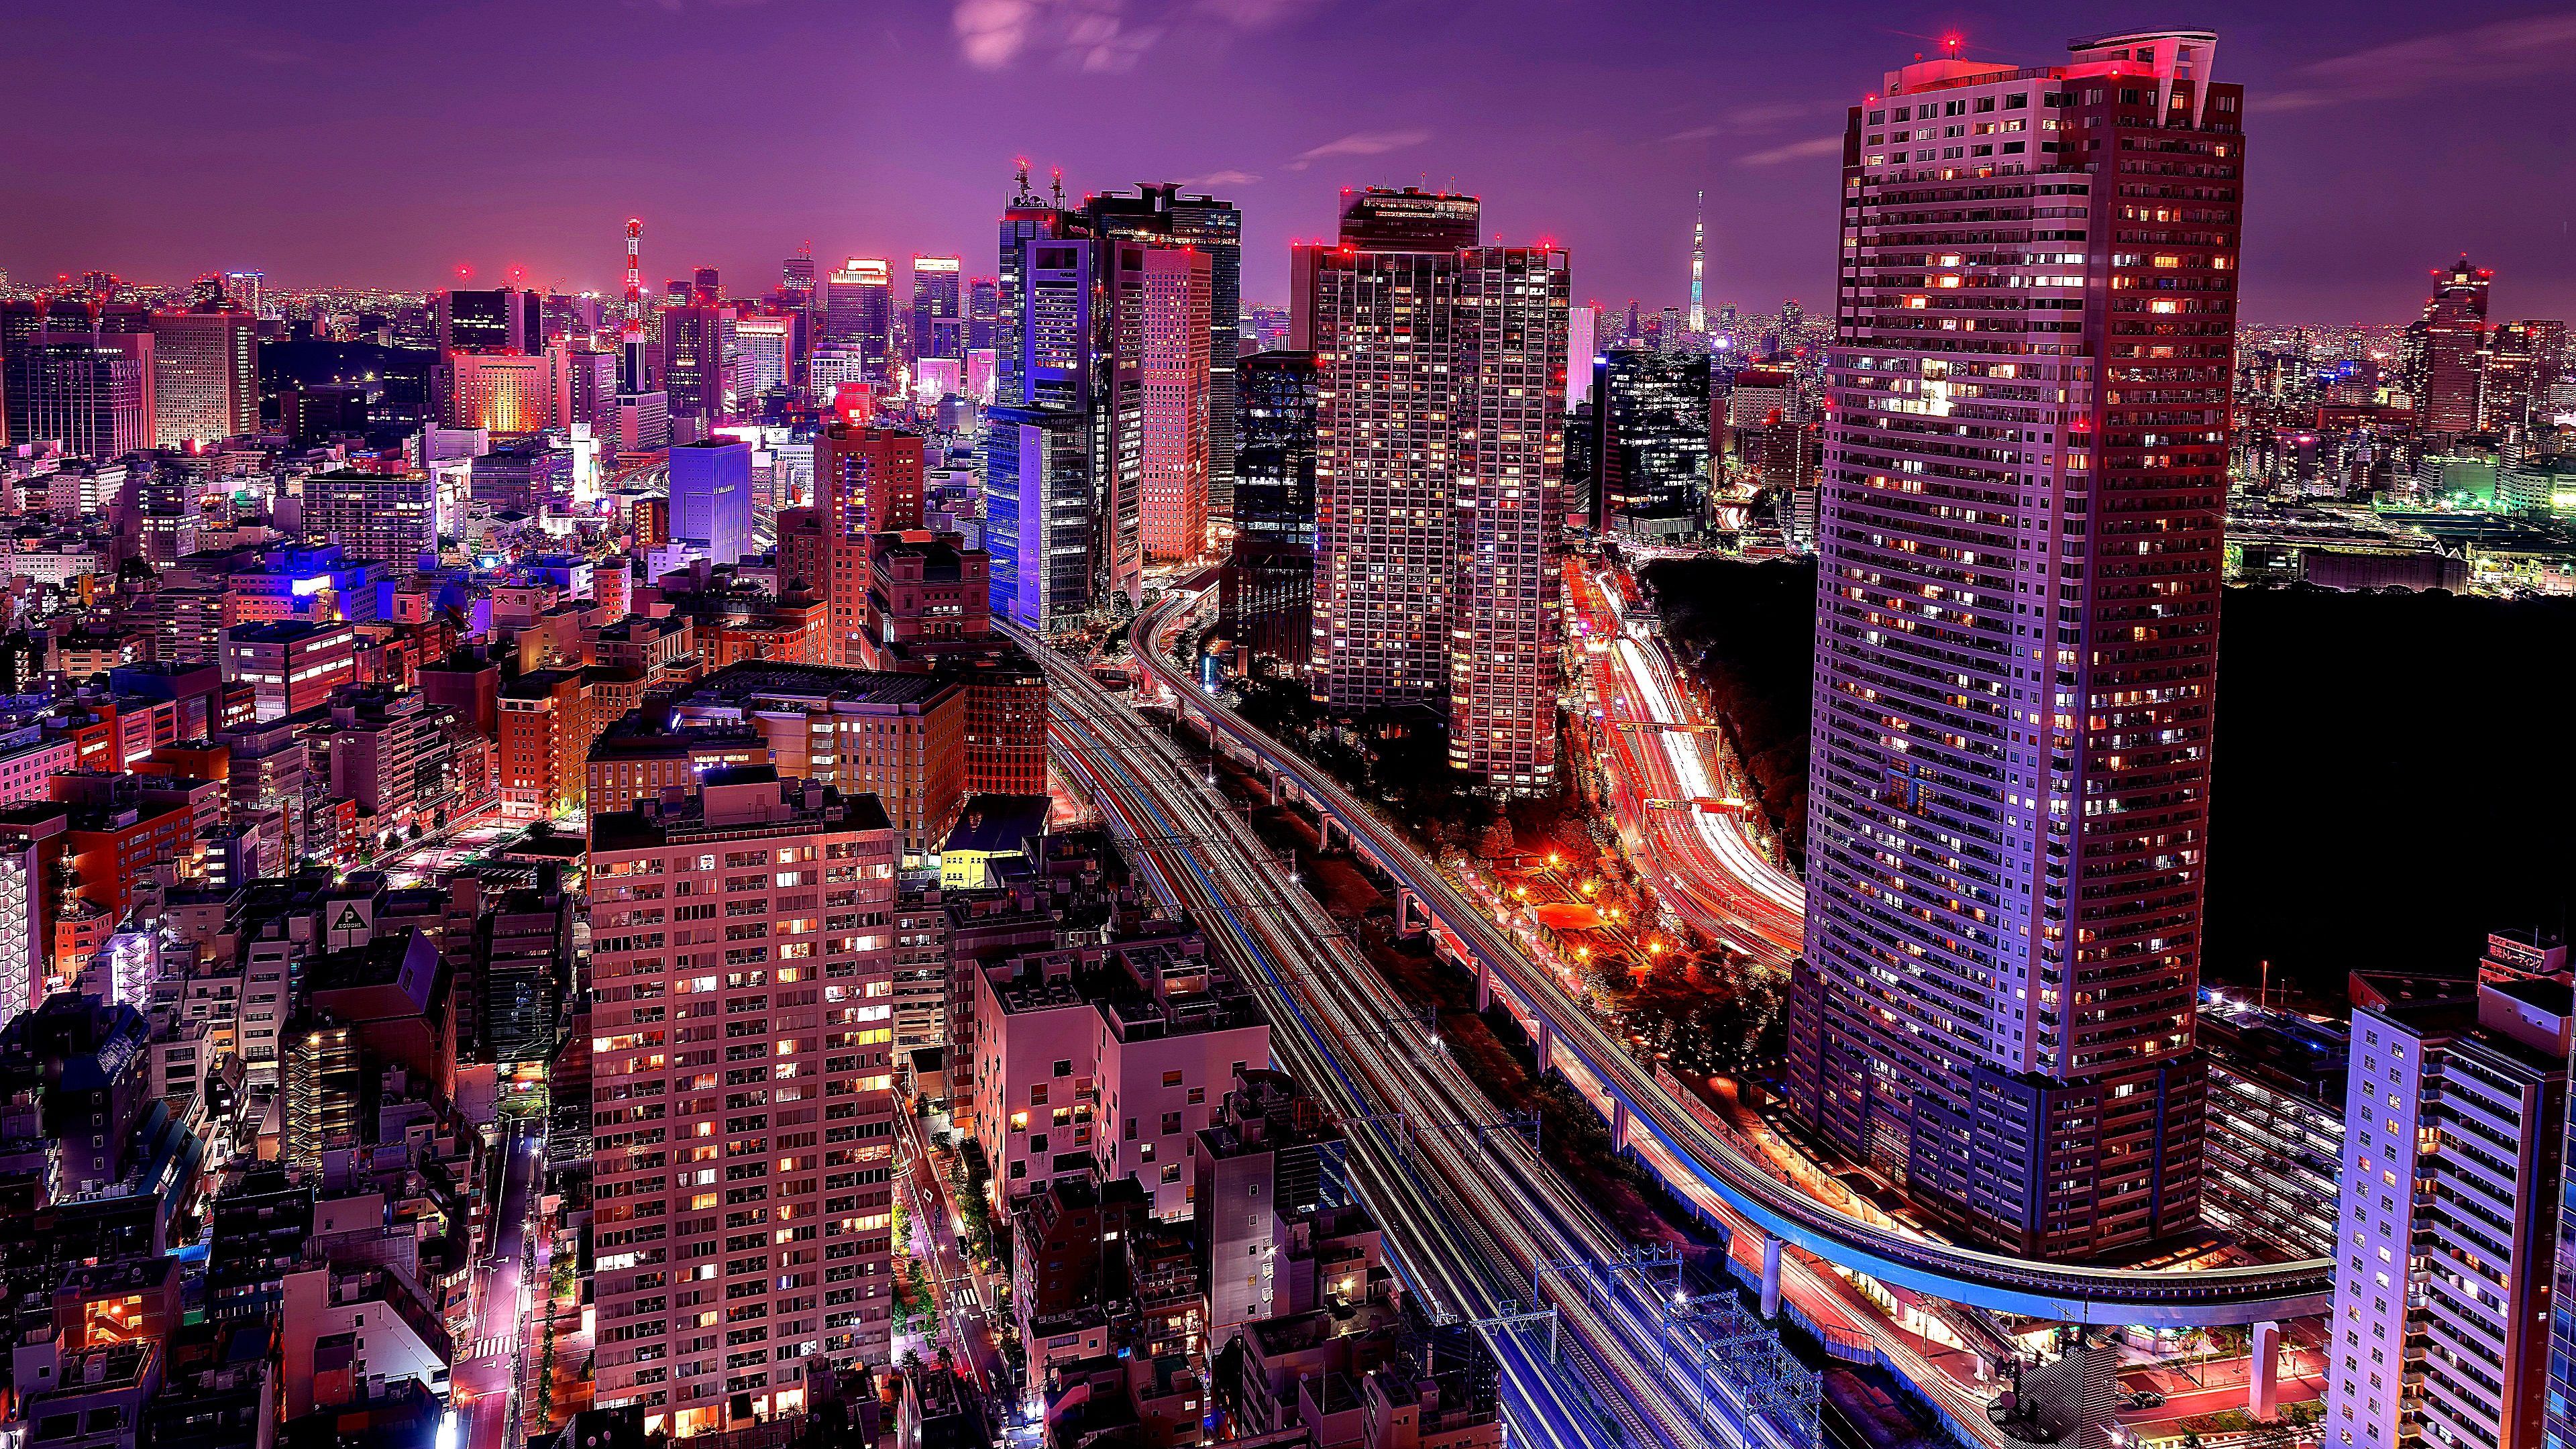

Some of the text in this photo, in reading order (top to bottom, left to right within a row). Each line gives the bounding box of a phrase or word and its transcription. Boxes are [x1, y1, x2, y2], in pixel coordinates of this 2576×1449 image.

[496, 594, 527, 606] 大信
[533, 591, 540, 611] 大信
[345, 911, 354, 922] P
